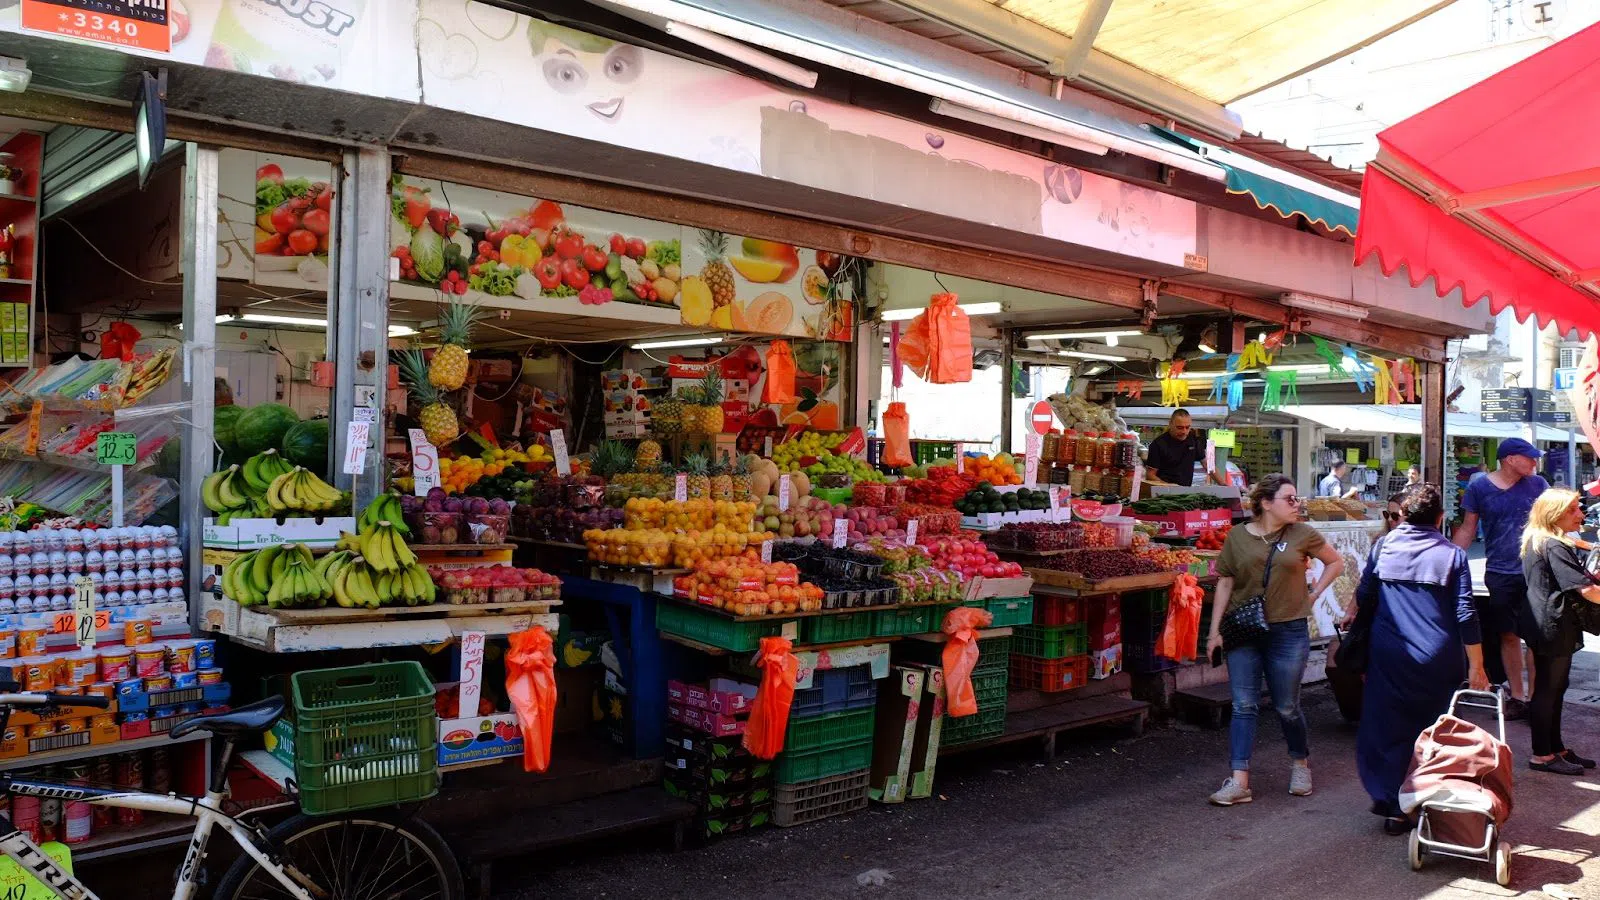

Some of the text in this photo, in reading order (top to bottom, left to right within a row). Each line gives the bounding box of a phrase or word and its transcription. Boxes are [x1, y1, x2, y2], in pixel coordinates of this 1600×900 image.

[415, 445, 433, 471] 5
[56, 615, 78, 633] 12
[78, 615, 94, 641] 12
[16, 840, 96, 900] TRE
